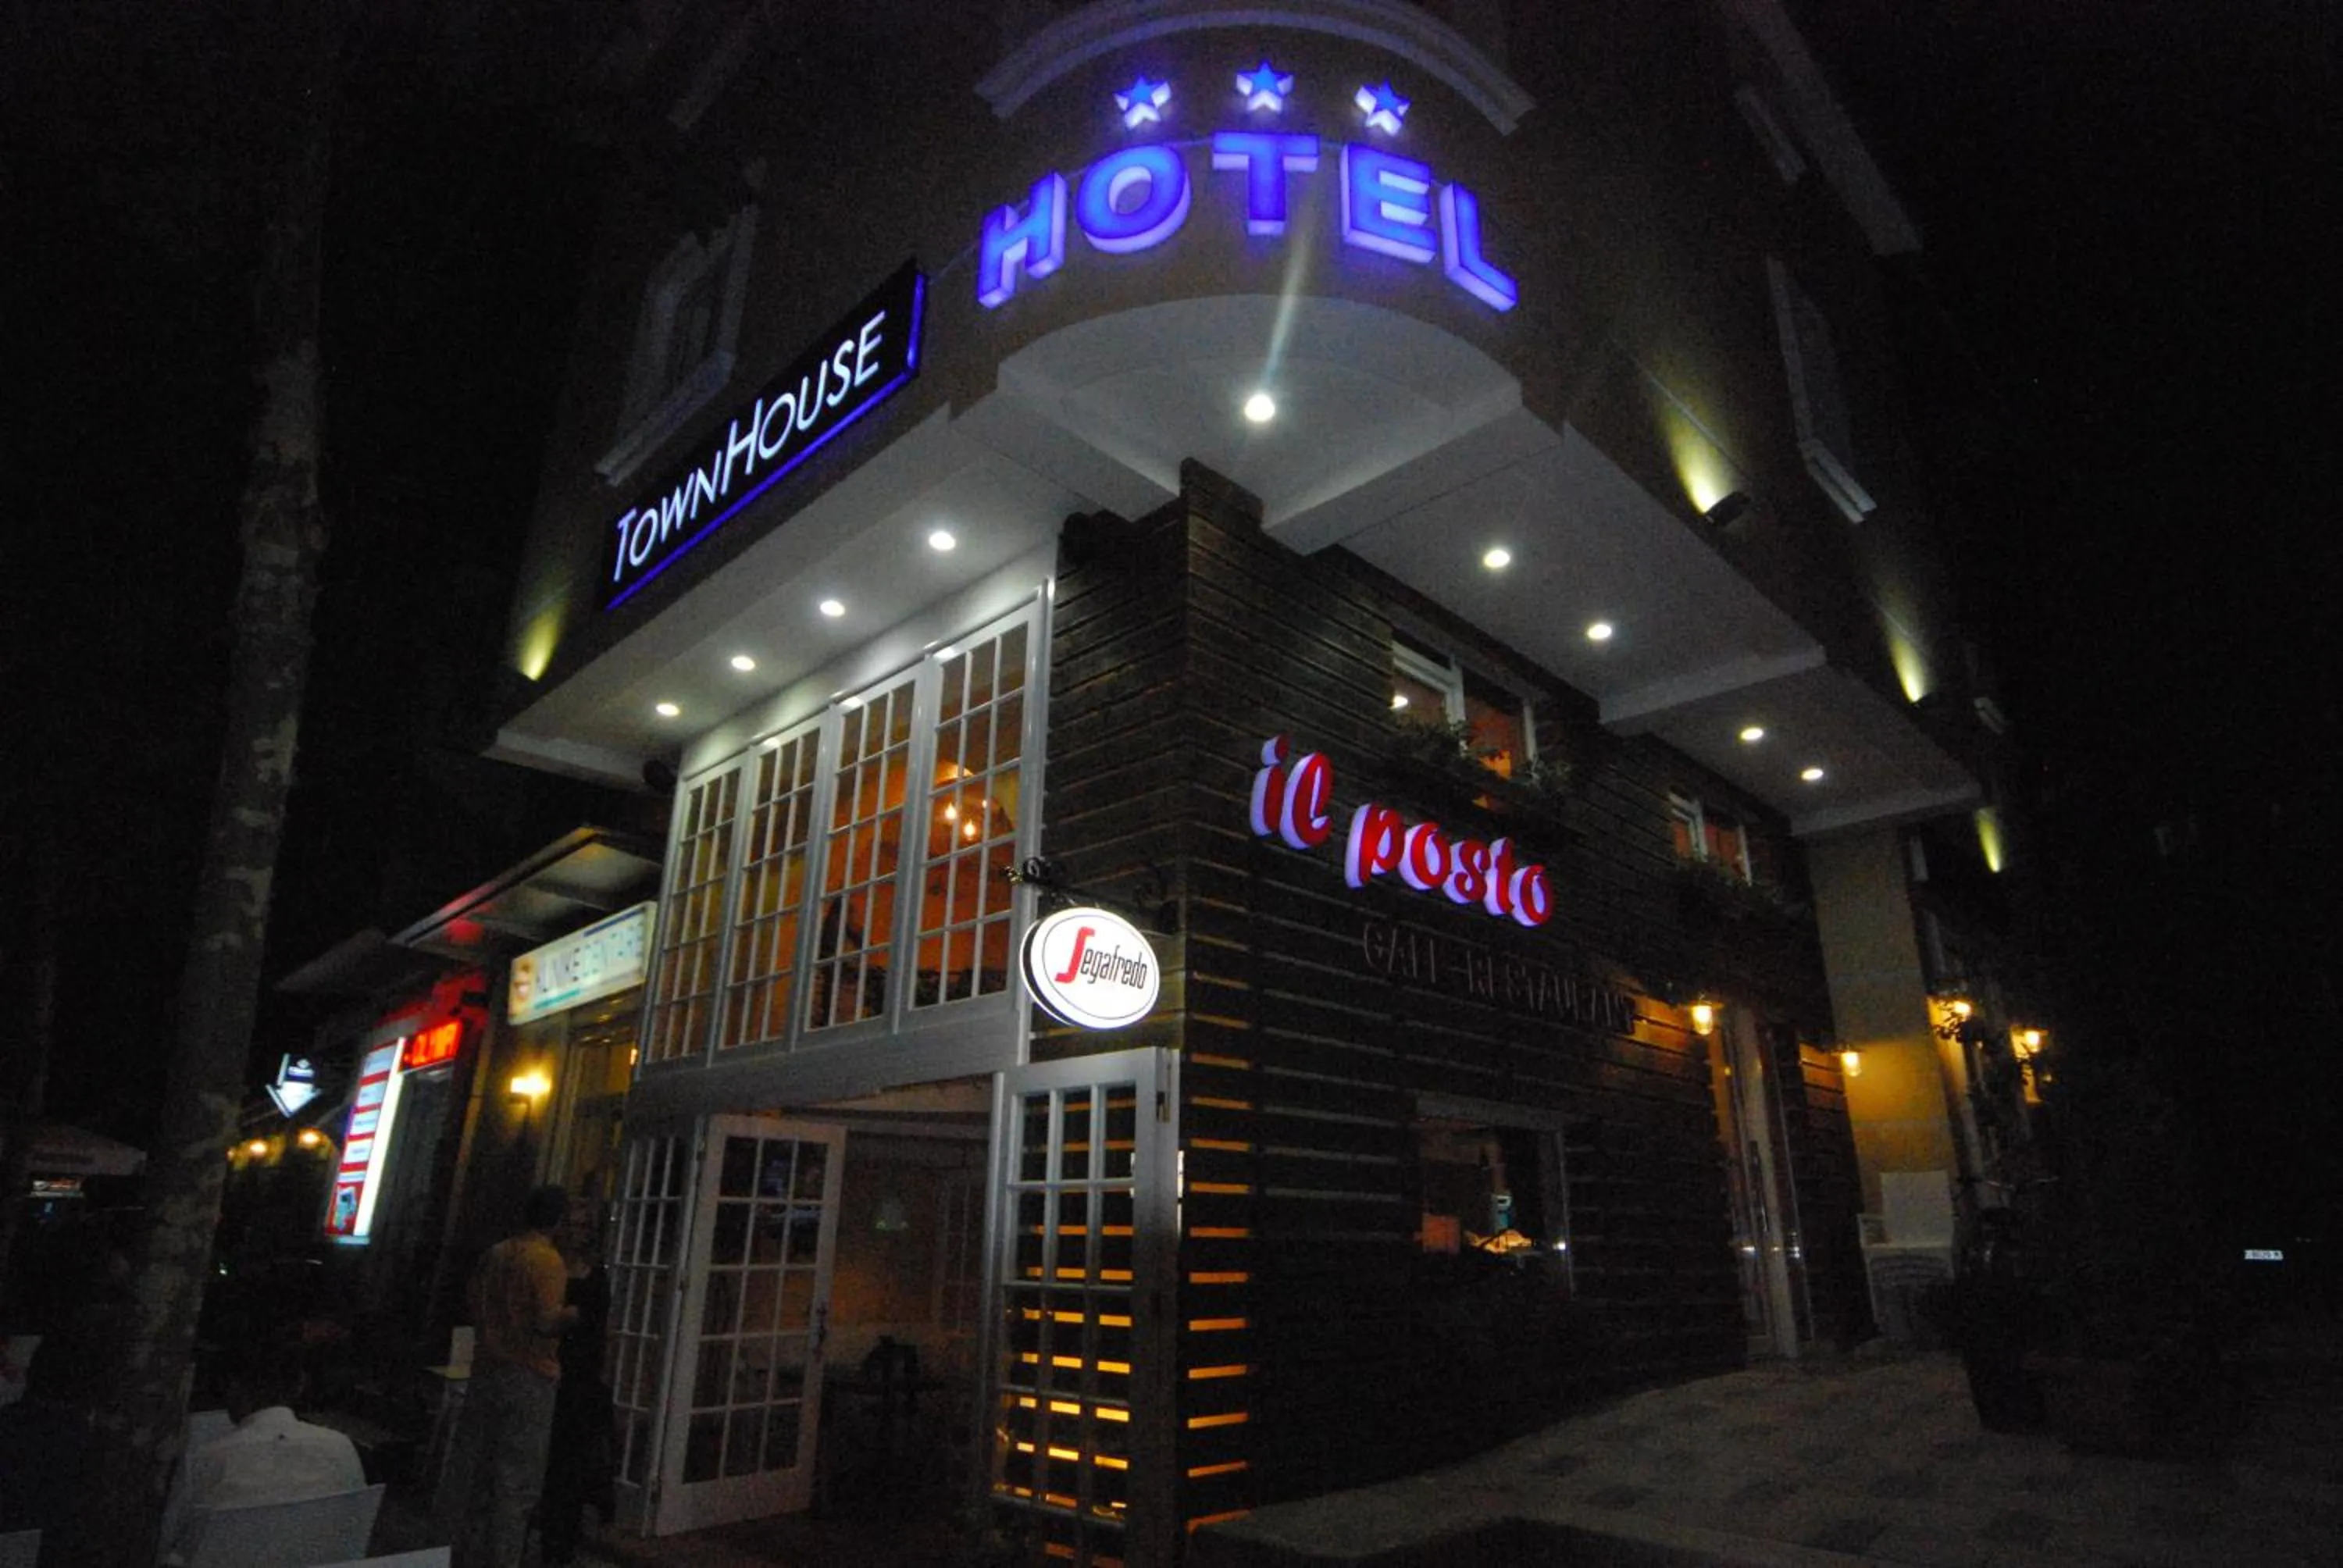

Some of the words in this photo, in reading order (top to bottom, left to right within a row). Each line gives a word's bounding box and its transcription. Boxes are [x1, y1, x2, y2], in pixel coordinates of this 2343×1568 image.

[977, 131, 1517, 309] HOTEL
[613, 310, 886, 582] TOWNHOUSE
[1344, 801, 1556, 928] posto
[1054, 926, 1148, 990] Segafredo
